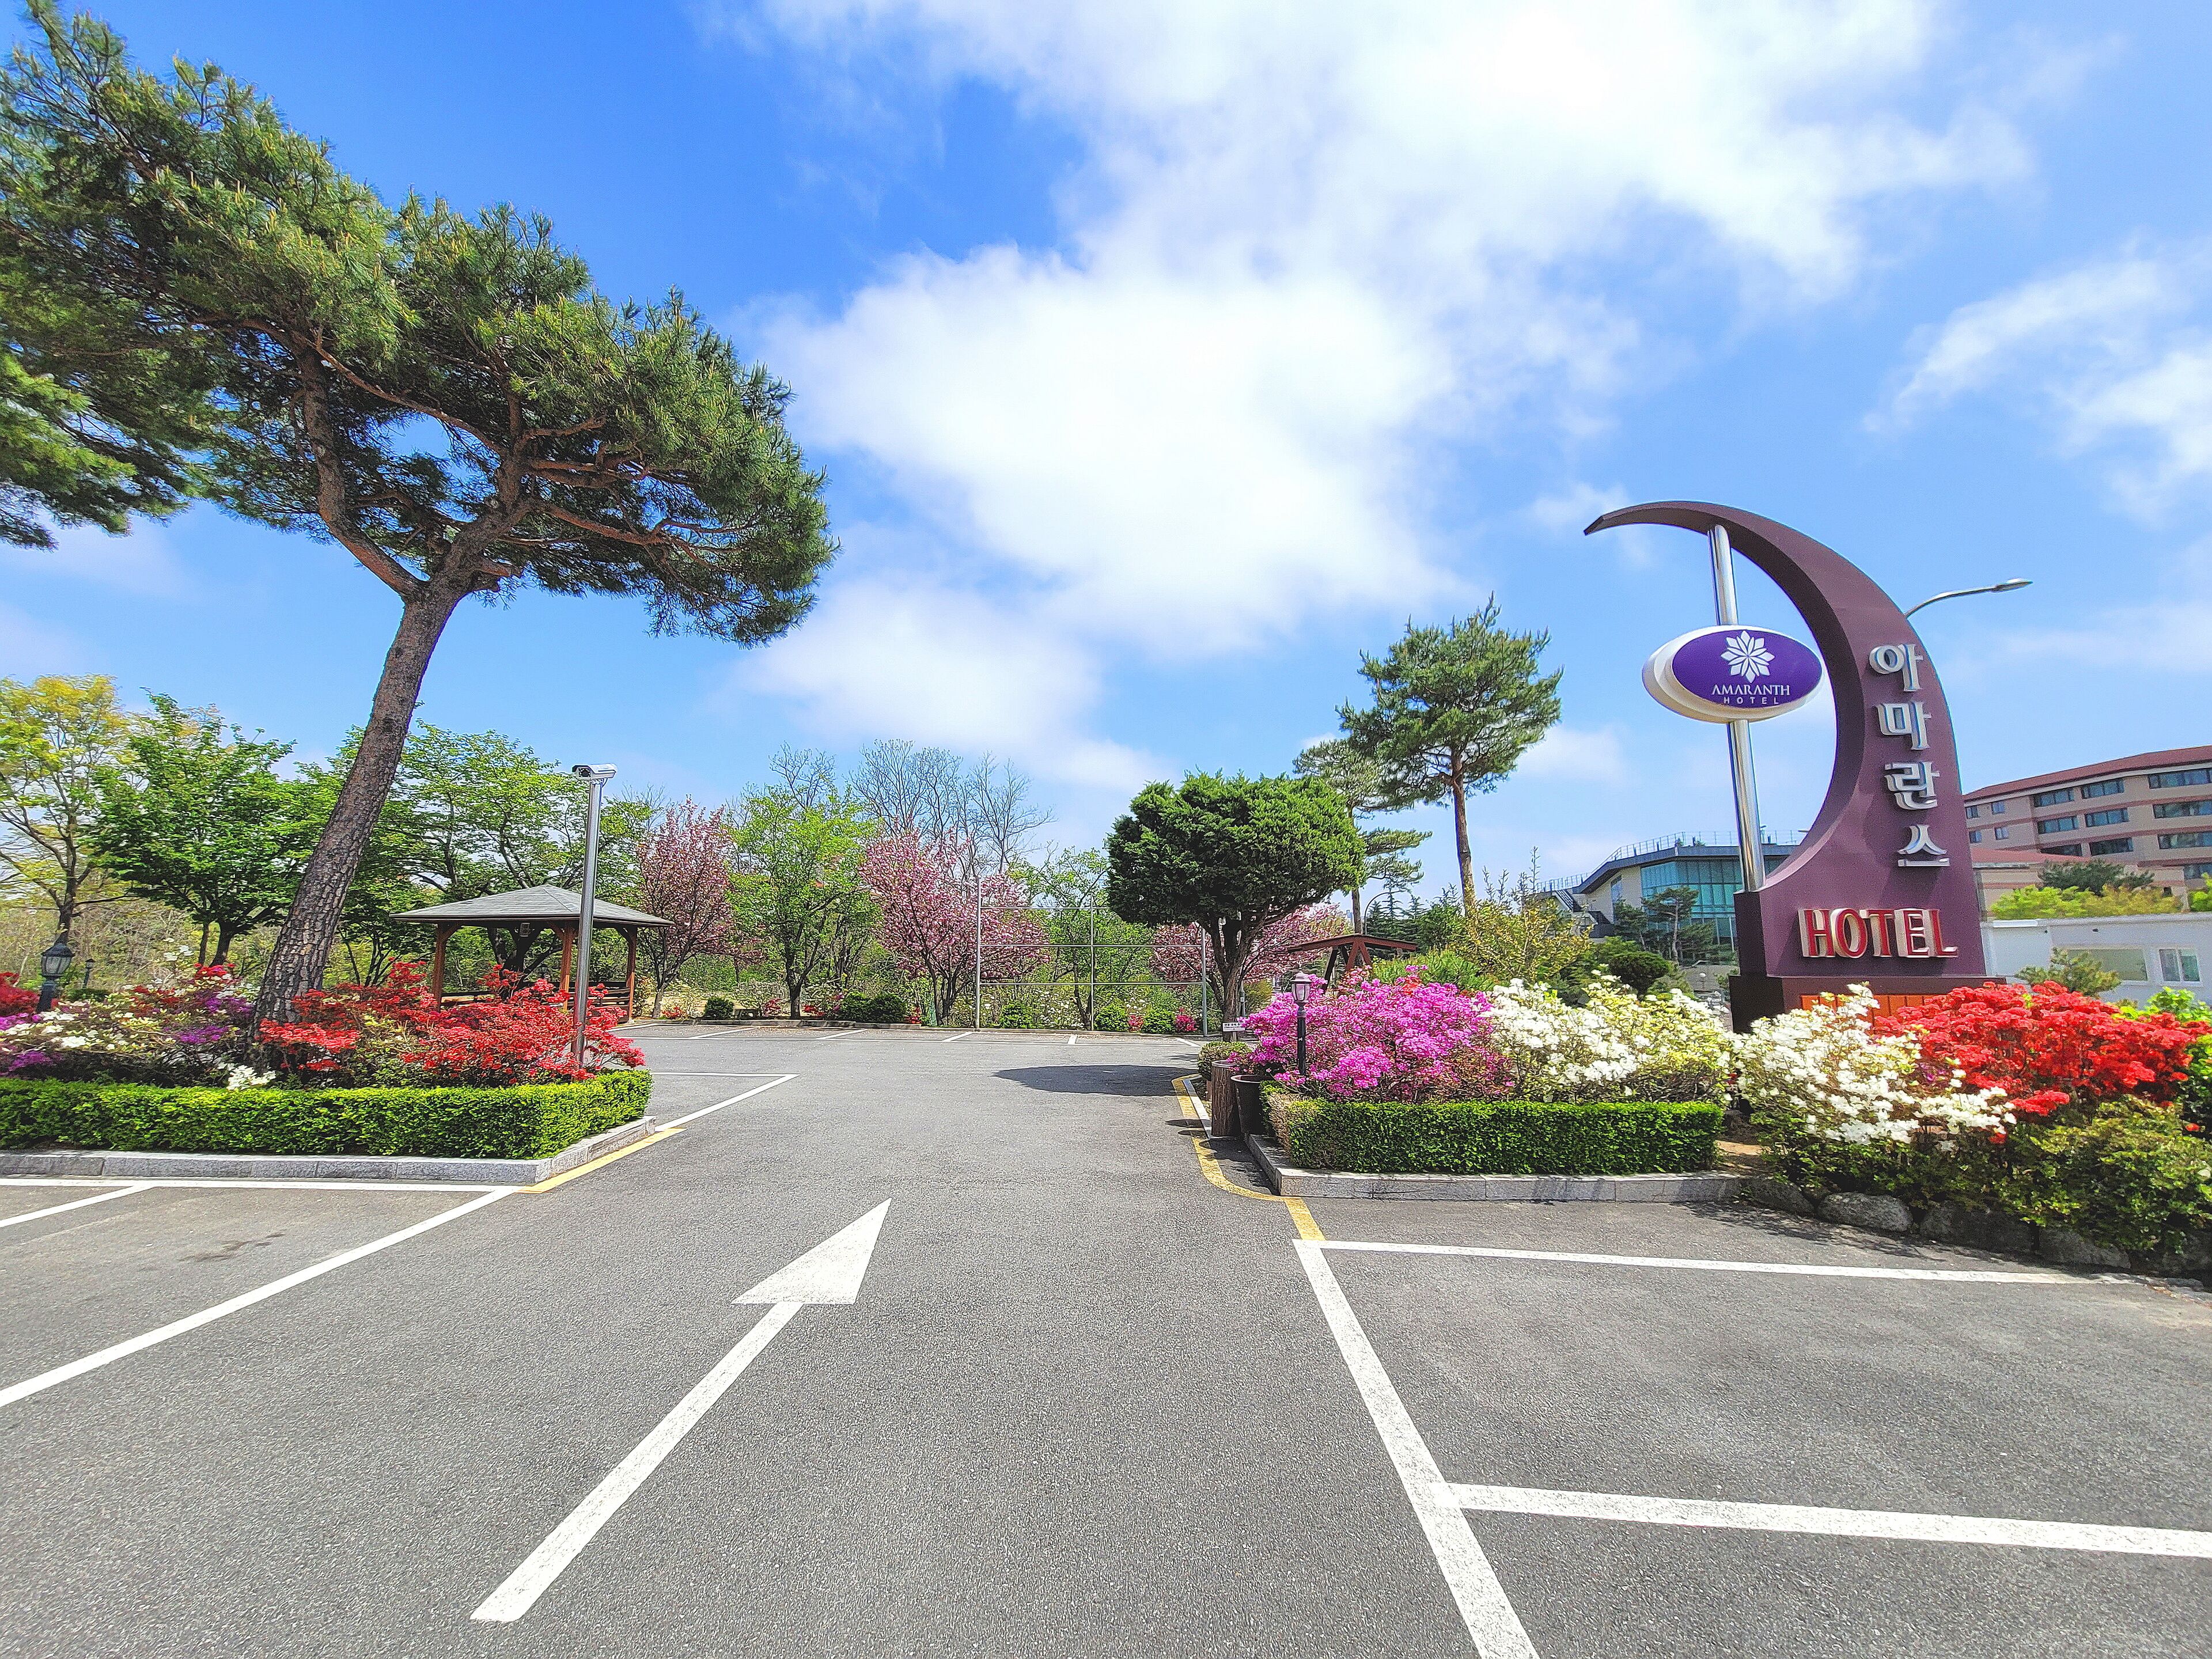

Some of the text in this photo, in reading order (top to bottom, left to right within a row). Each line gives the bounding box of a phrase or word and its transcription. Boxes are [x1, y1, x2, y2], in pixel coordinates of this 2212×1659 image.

[1711, 684, 1790, 695] AMARANTH
[1724, 696, 1779, 704] HOTEL
[1870, 643, 1950, 867] 아마란스
[1798, 908, 1958, 958] HOTEL
